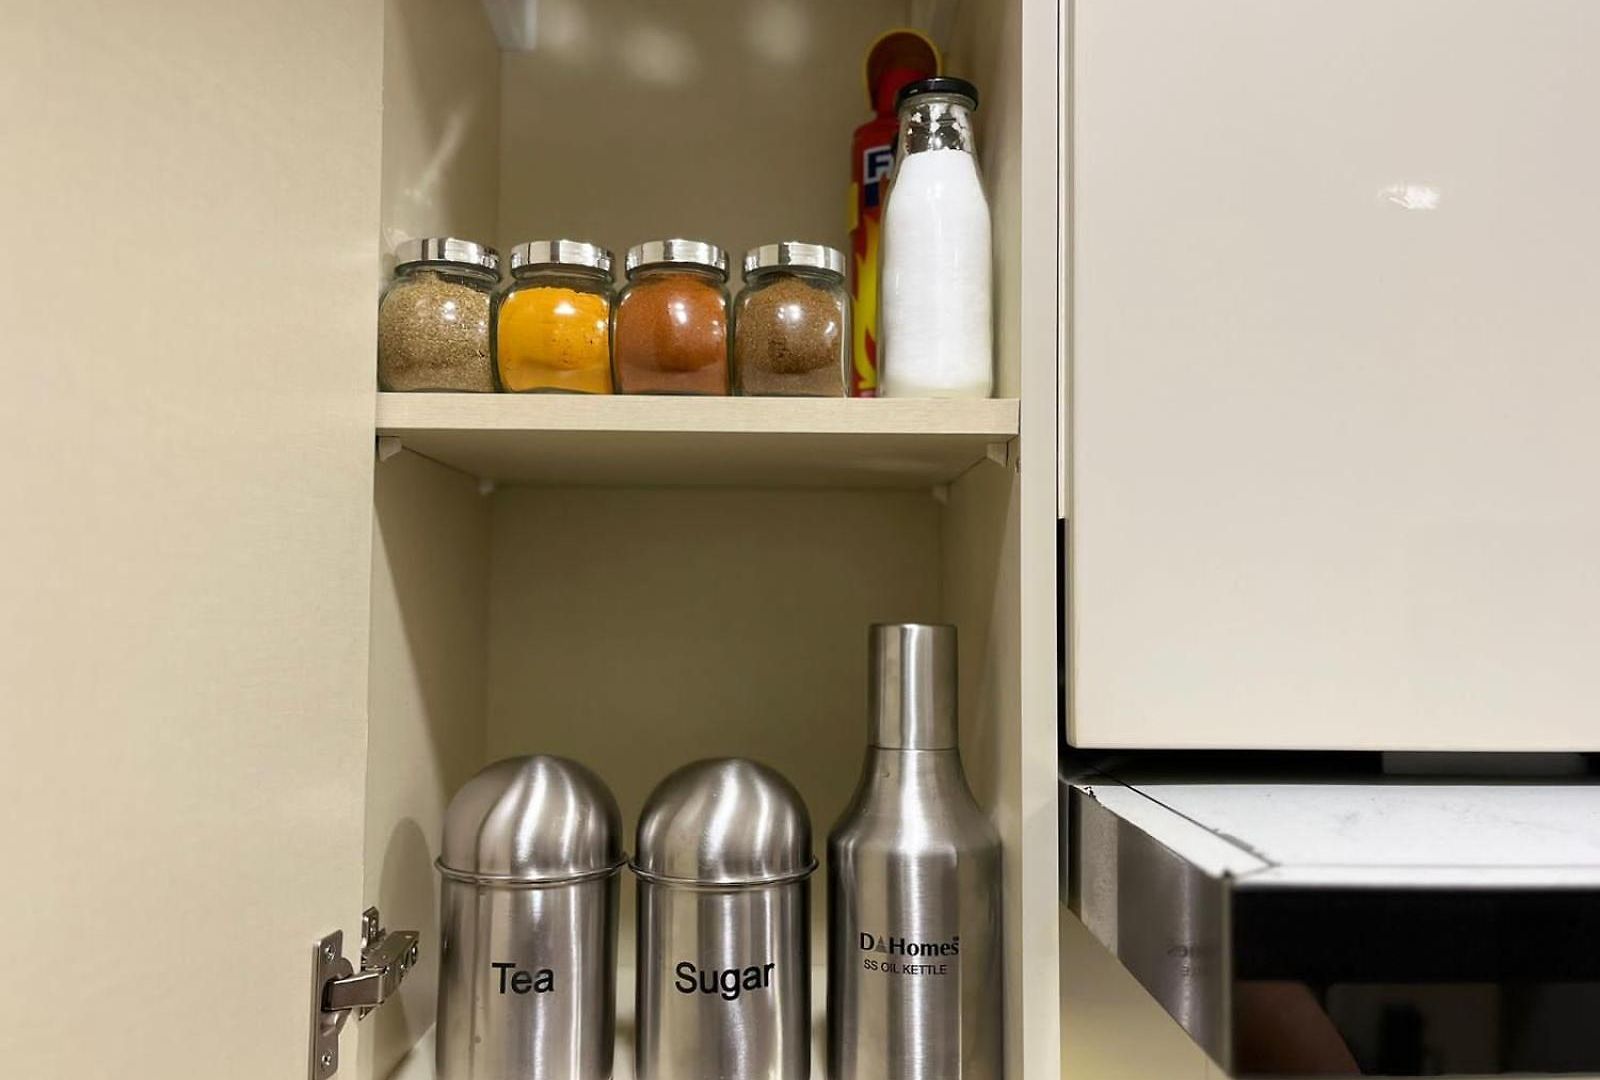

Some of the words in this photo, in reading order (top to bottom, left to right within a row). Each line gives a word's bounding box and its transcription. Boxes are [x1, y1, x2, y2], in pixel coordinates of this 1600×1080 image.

[492, 962, 554, 994] Tea
[675, 961, 775, 1001] Sugar
[863, 959, 878, 971] SS
[881, 962, 900, 973] OIL
[902, 964, 947, 975] KETTLE
